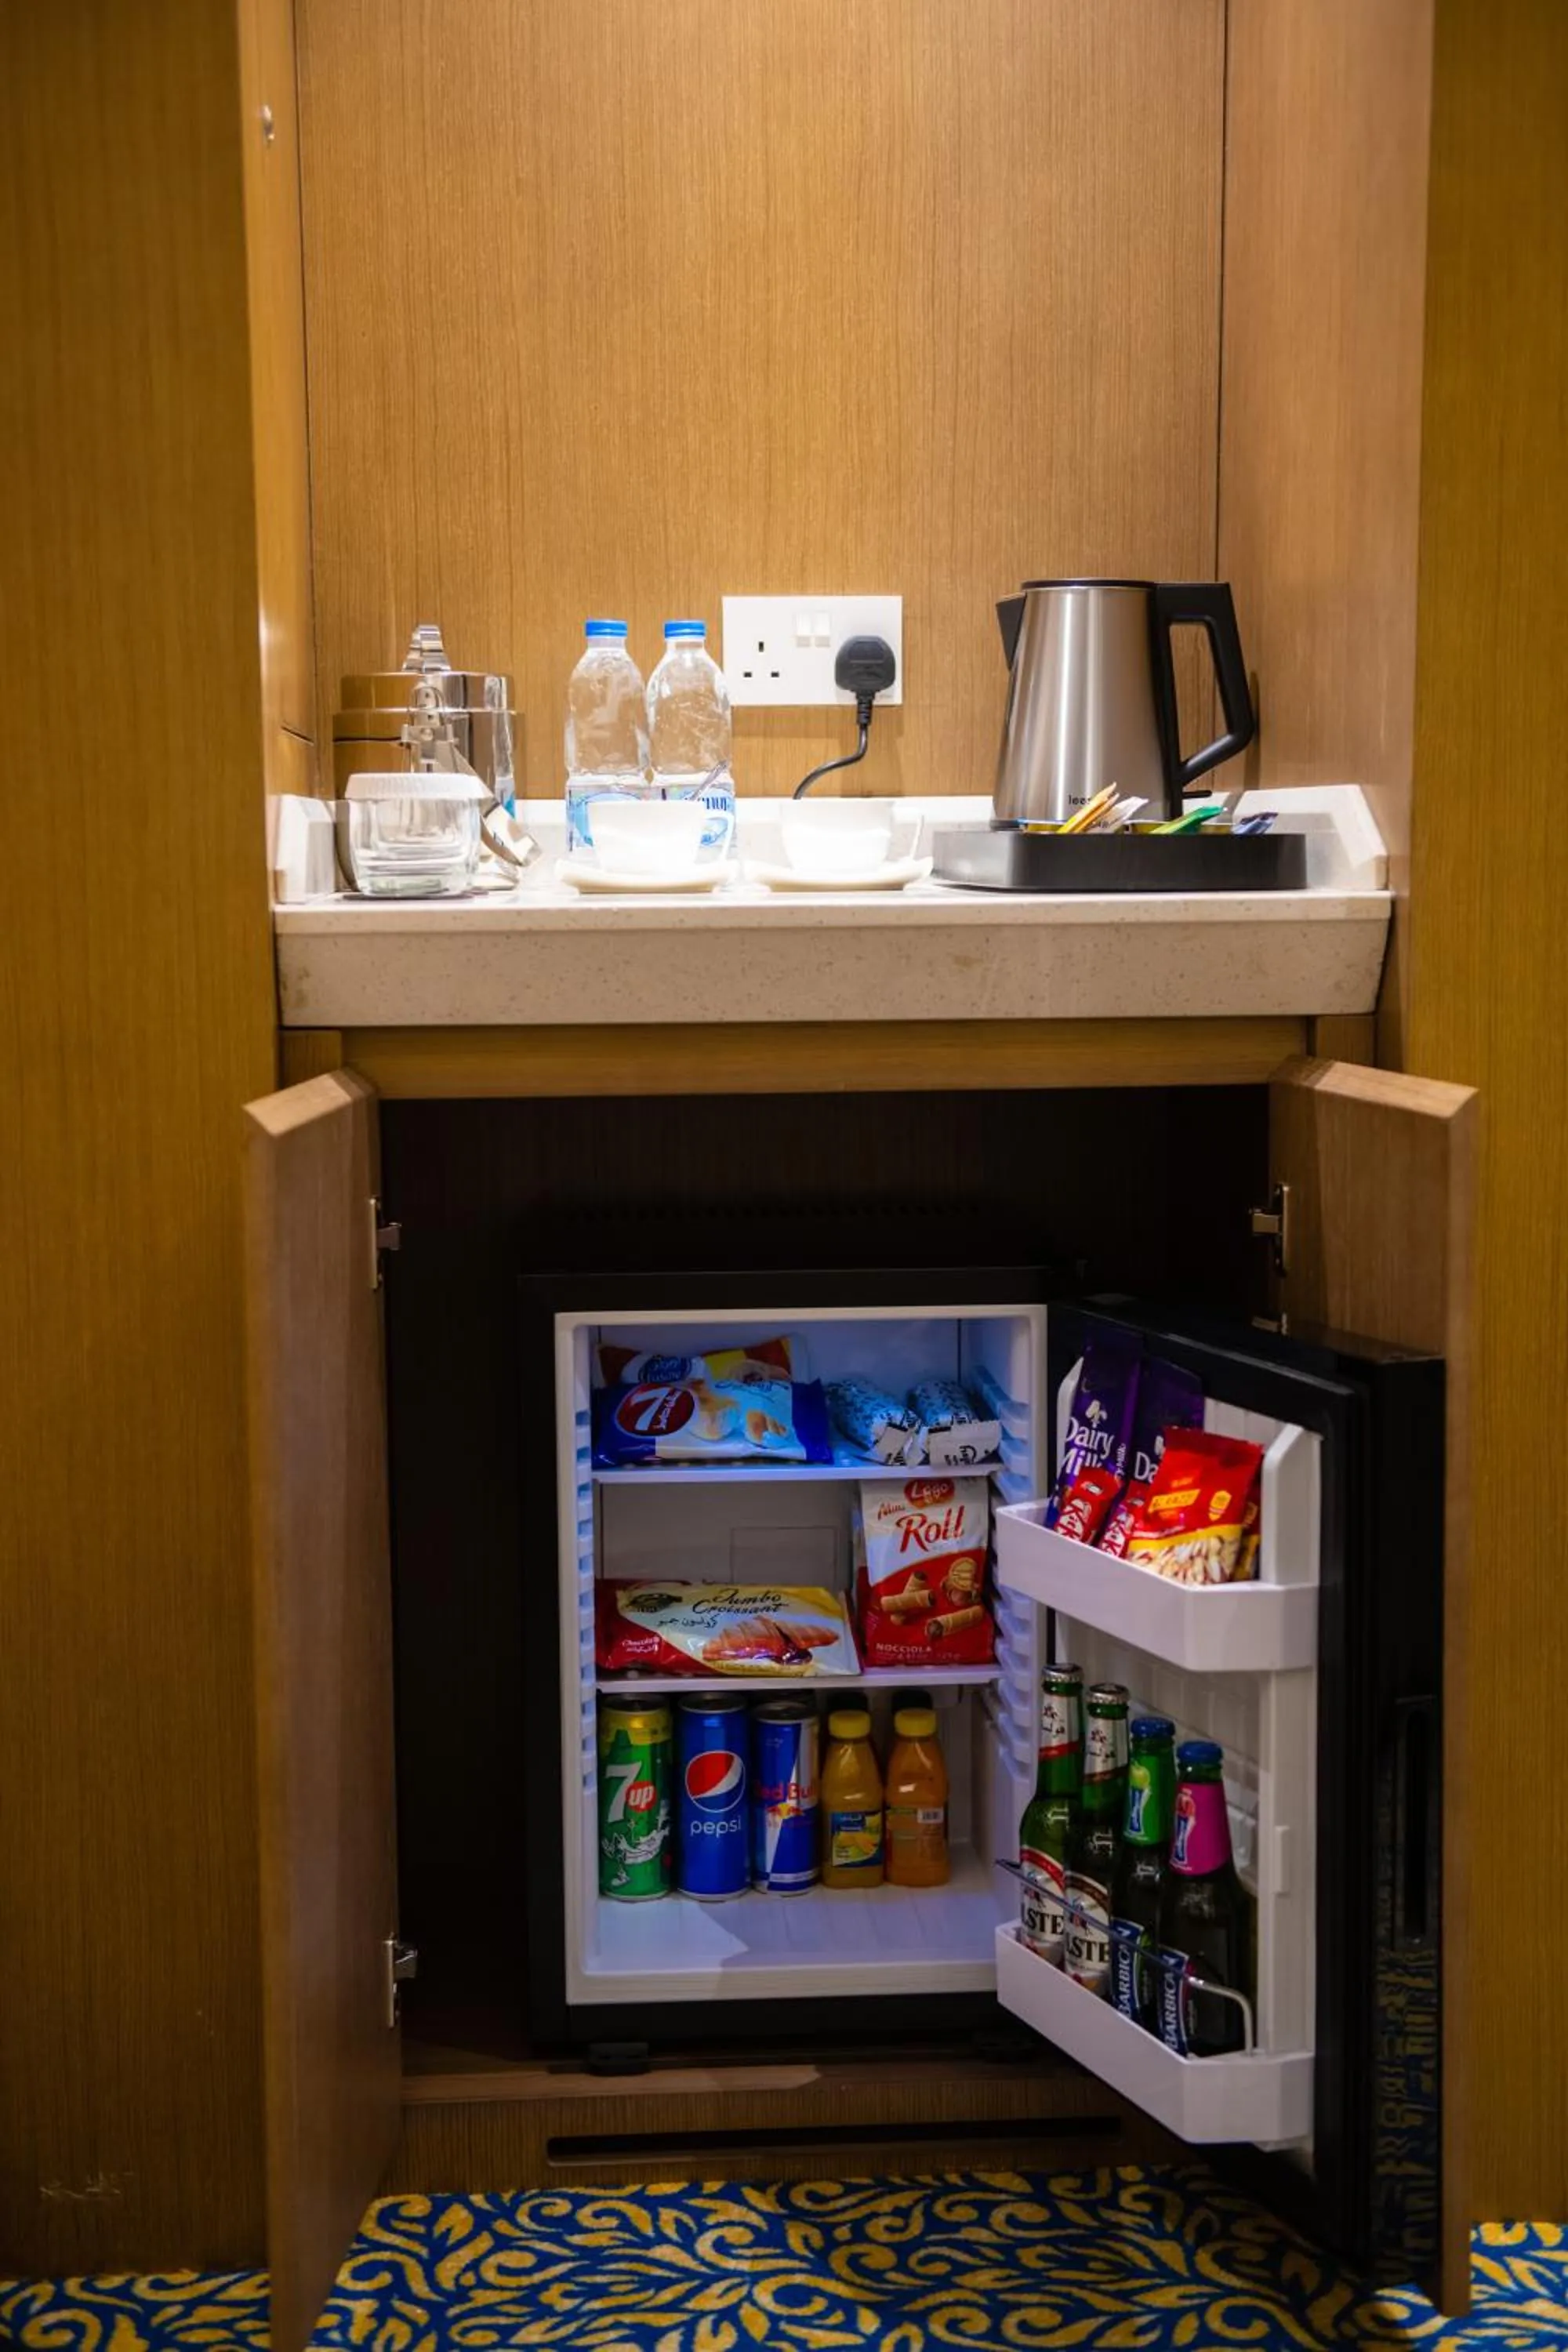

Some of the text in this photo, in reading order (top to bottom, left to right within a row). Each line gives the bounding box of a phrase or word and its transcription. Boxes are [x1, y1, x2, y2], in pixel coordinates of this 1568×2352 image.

[1065, 1417, 1116, 1461] Dairy
[895, 1504, 965, 1554] Roll
[692, 1599, 789, 1615] Croissant
[713, 1588, 782, 1606] Jumbo
[876, 1642, 933, 1653] NOCCIOLA
[690, 1815, 742, 1838] pepsi
